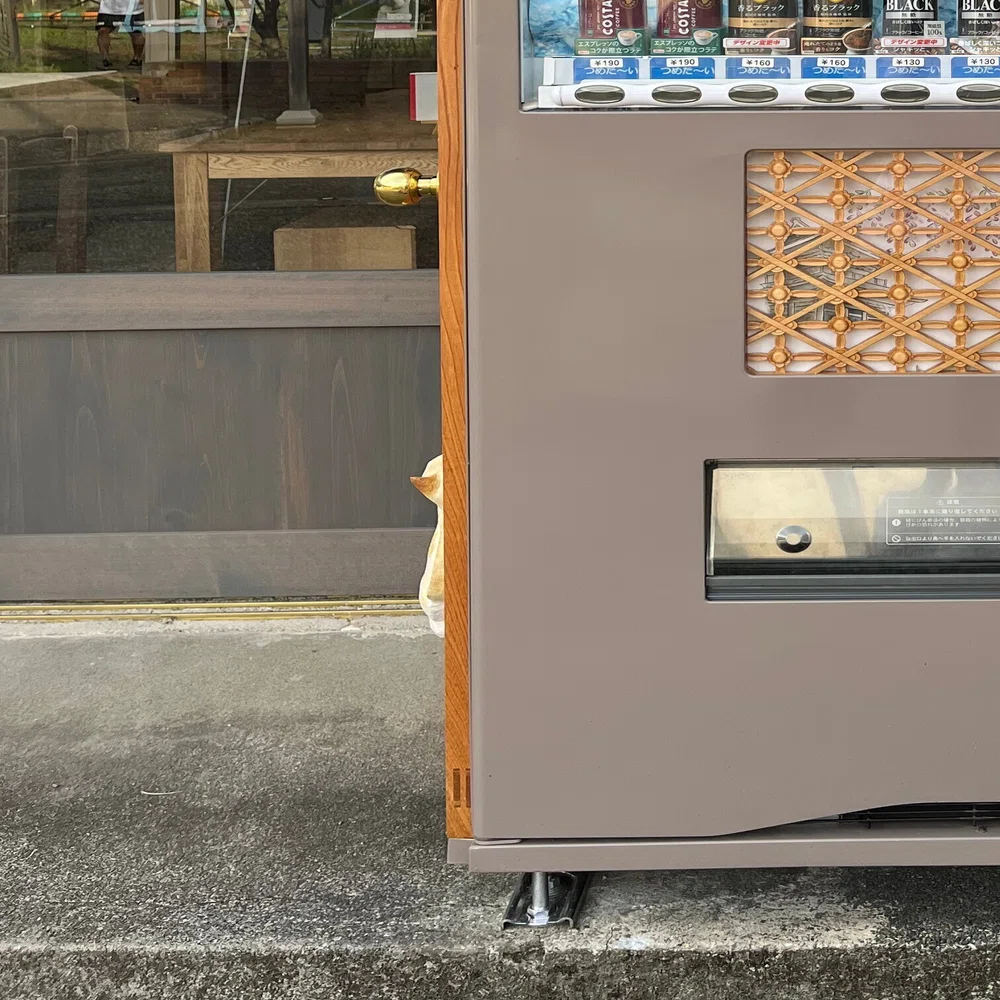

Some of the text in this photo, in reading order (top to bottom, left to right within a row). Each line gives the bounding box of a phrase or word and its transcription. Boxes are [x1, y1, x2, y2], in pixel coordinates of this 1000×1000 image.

[738, 4, 785, 12] 香るブラック
[813, 4, 861, 12] 香るブラック
[602, 0, 613, 35] COSTA
[678, 0, 689, 35] COSTA
[590, 47, 641, 55] コクが際立つラテ
[666, 47, 717, 55] コクが際立つラテ
